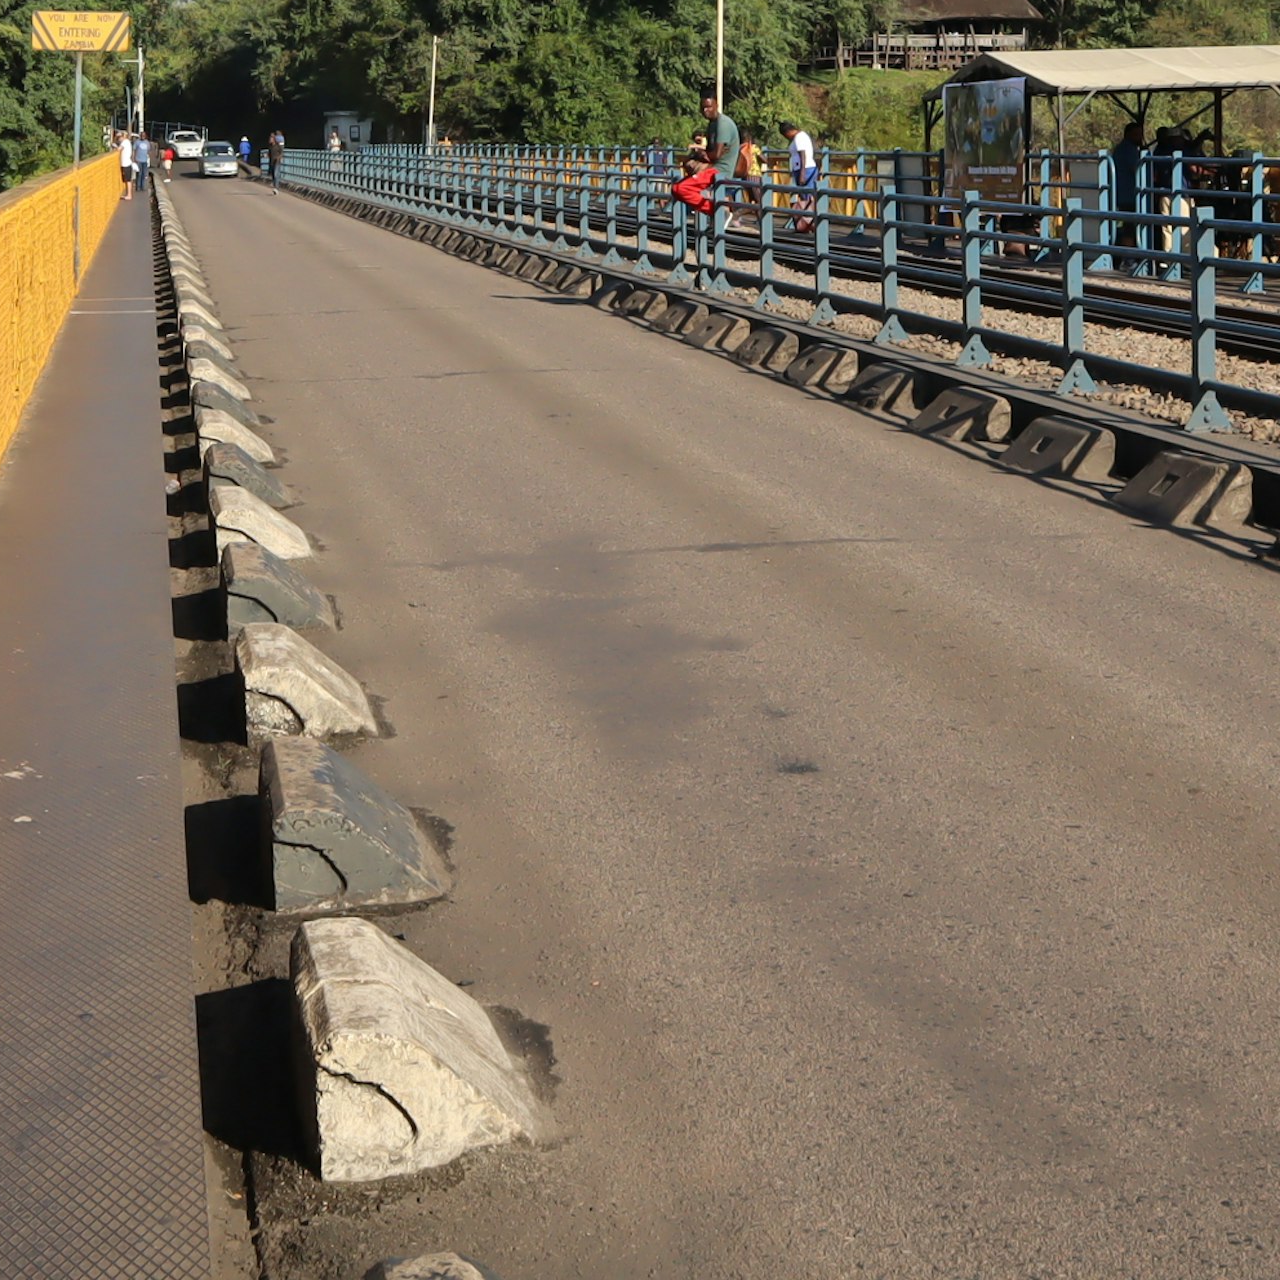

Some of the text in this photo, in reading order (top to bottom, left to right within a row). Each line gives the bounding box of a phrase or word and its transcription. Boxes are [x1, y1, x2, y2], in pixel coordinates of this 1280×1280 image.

[48, 14, 116, 22] YOU ARE NOW
[58, 27, 101, 38] ENTERING
[63, 40, 95, 49] ZAMBIA
